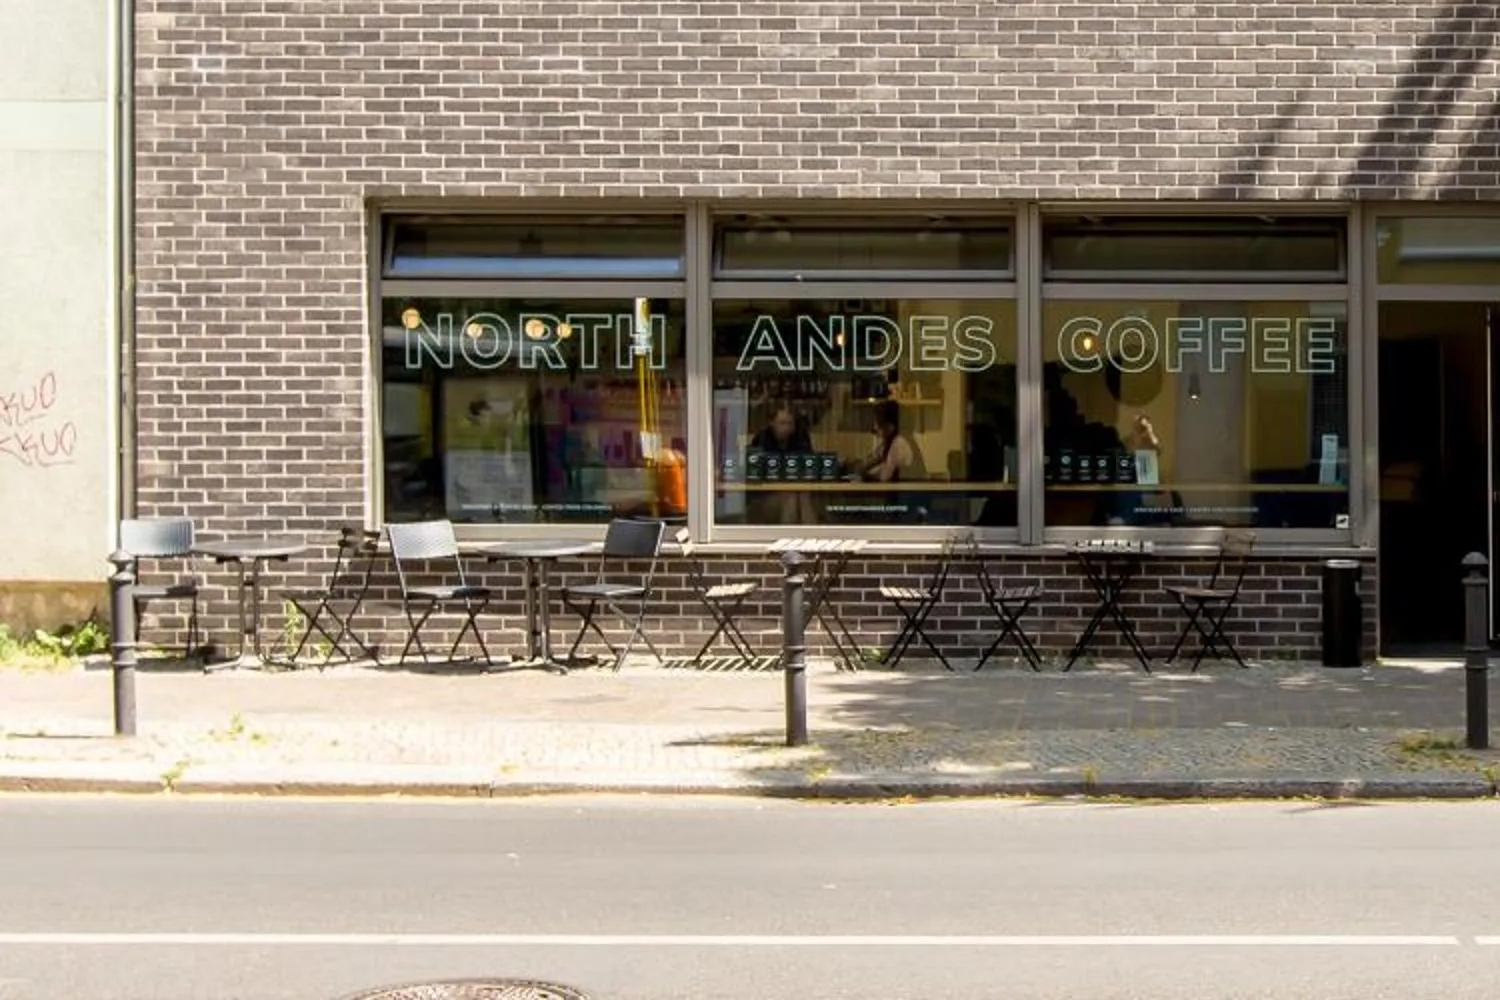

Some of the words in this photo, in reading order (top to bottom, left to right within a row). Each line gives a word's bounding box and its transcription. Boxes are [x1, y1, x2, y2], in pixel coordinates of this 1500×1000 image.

[405, 313, 666, 369] NORTH
[736, 315, 997, 372] ANDES
[1057, 316, 1335, 373] COFFEE
